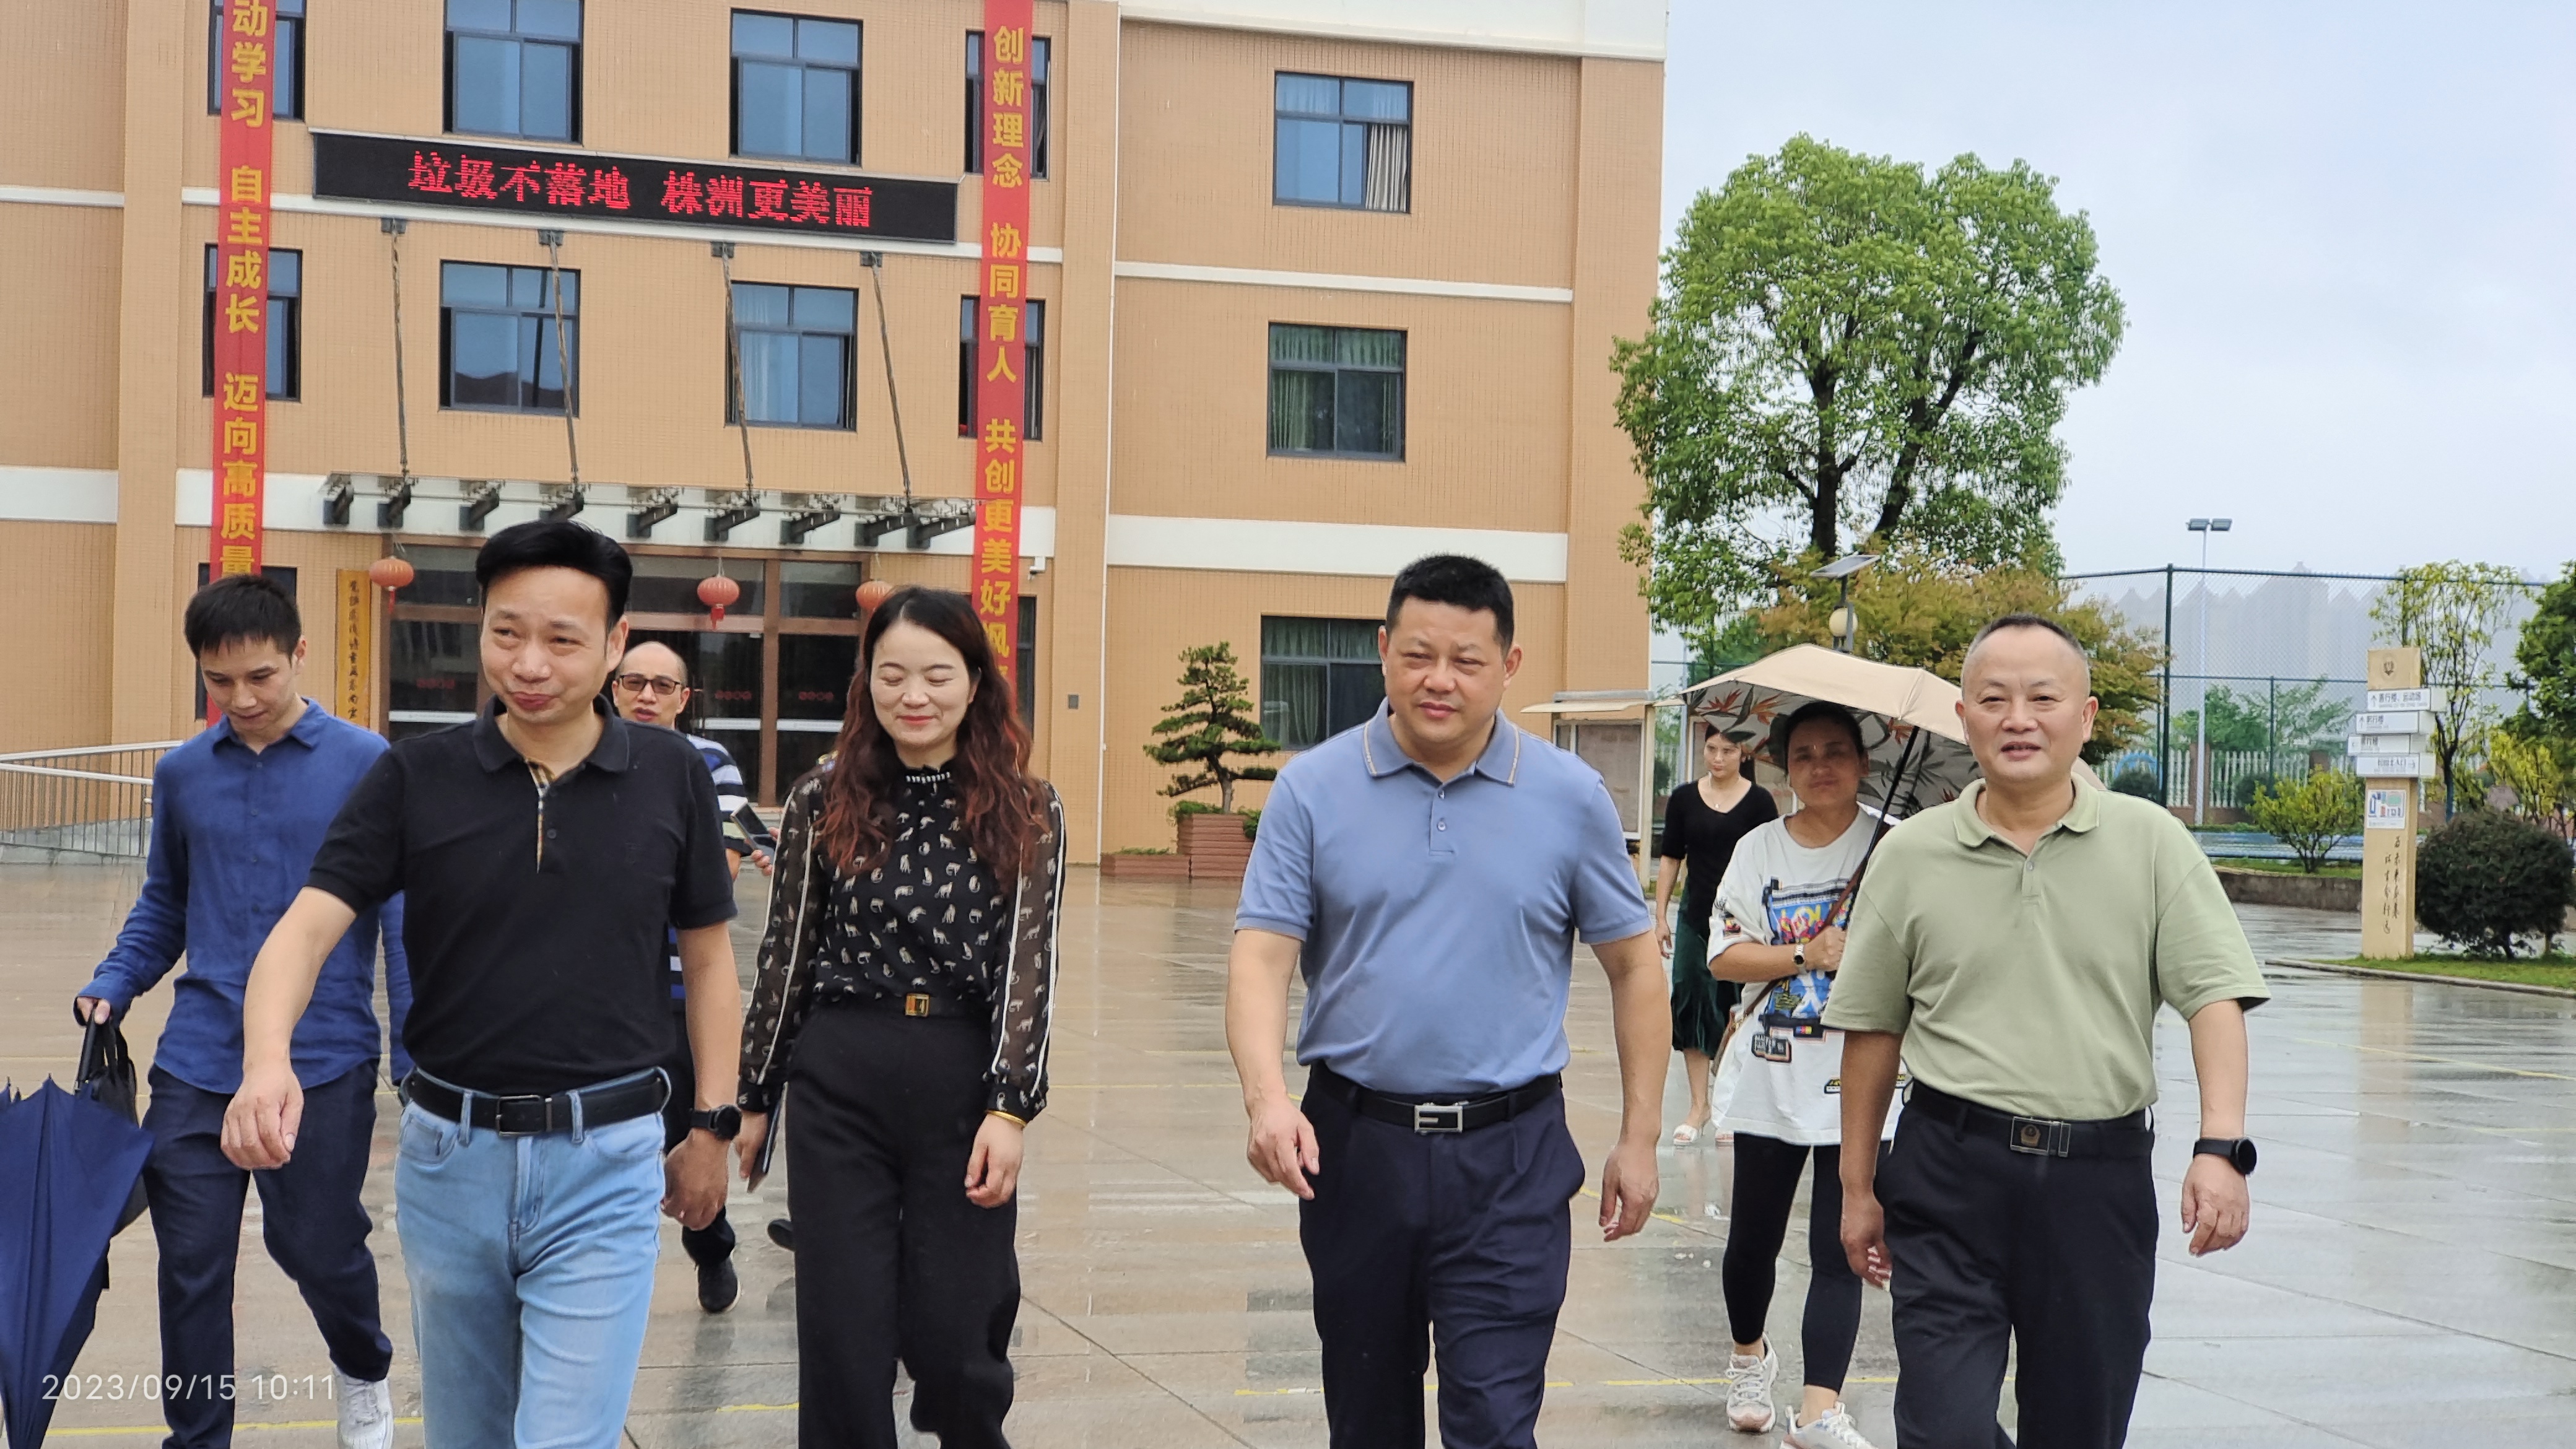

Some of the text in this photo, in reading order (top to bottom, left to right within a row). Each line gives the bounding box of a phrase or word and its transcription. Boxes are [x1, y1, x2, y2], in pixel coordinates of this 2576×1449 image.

[220, 0, 268, 577] 动学习 自主成长 迈向高质量
[408, 150, 873, 227] 垃圾不落地 株洲更美丽
[980, 25, 1024, 676] 创新理念 协同育人 共创更美好枫
